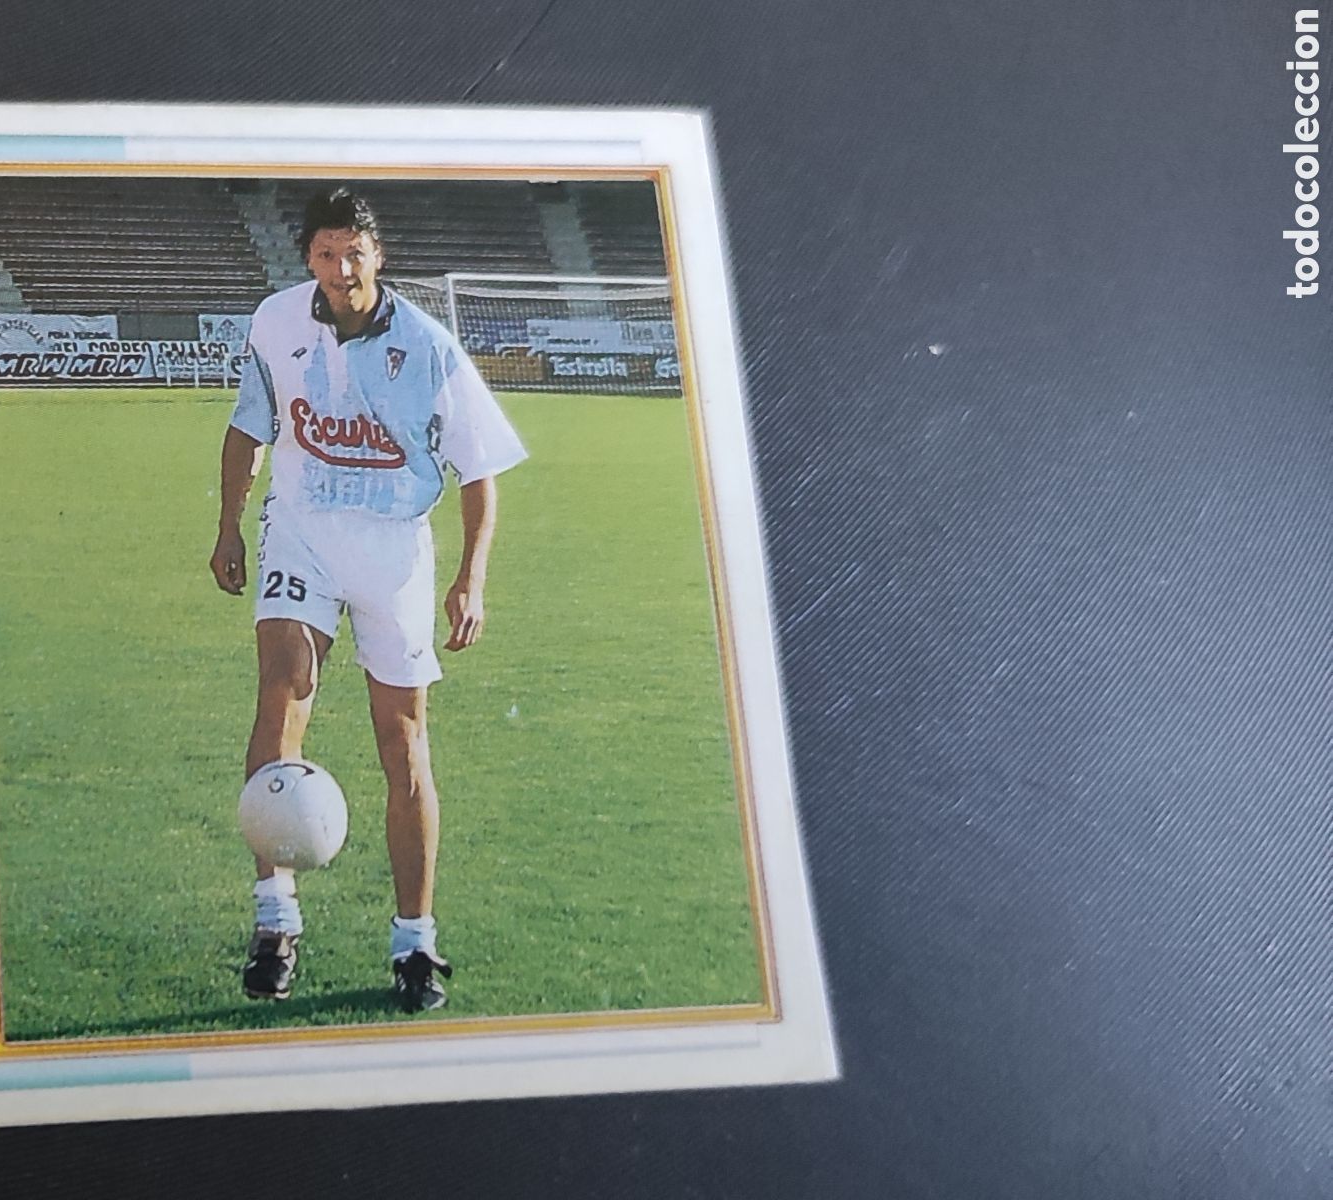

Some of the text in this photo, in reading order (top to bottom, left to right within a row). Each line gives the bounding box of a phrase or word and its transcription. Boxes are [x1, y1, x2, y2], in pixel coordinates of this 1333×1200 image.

[68, 354, 146, 377] MRW
[548, 355, 628, 378] Estrella
[263, 570, 307, 601] 25
